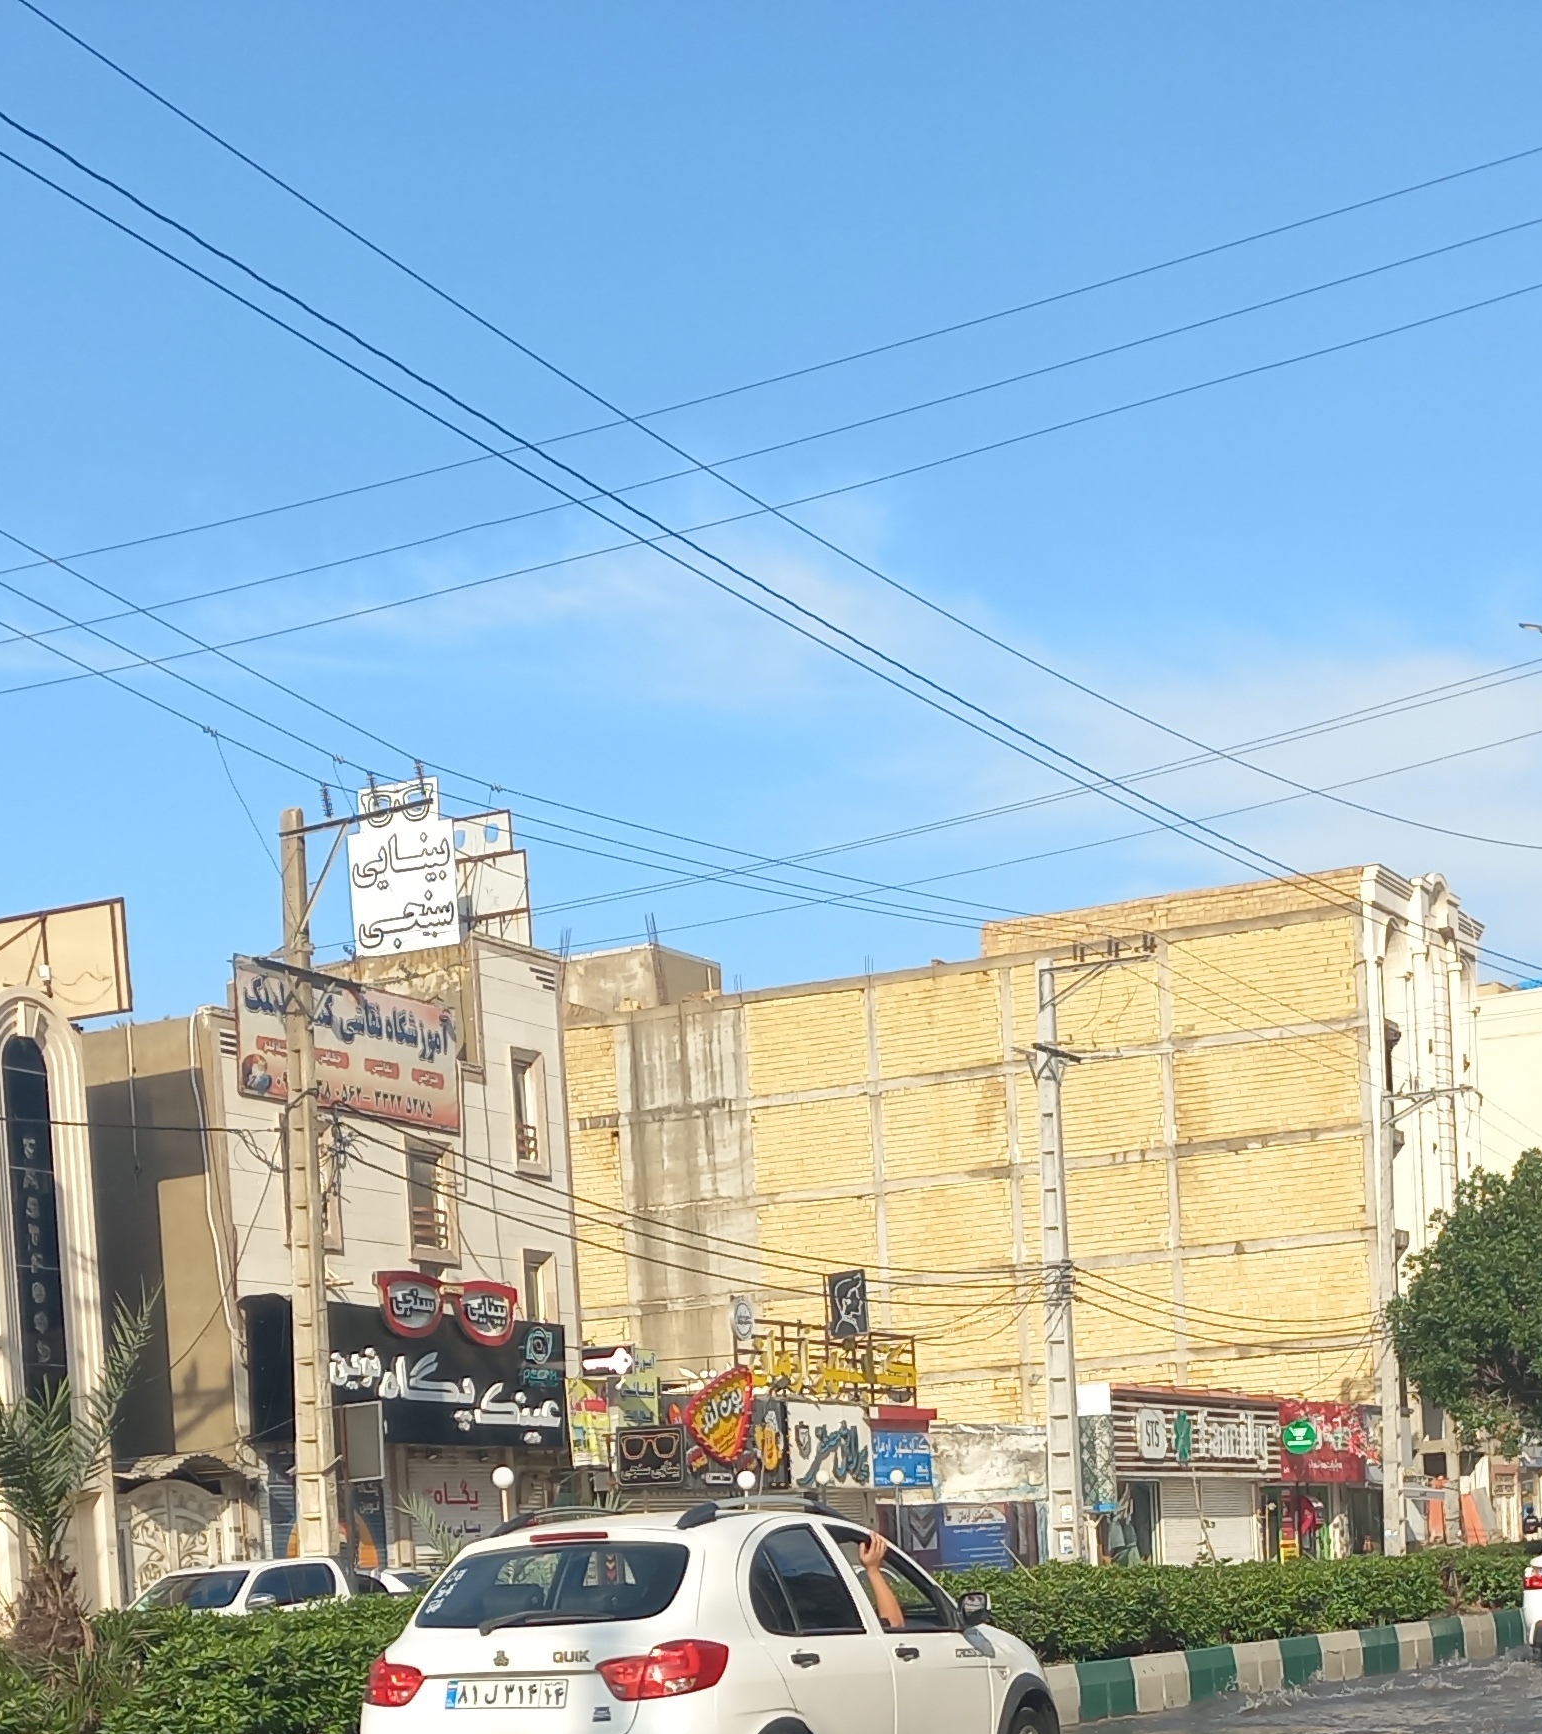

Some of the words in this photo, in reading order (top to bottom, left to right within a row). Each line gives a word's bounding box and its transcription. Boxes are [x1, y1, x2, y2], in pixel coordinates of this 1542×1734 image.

[352, 831, 450, 889] بینایی
[359, 889, 455, 949] سنجی
[473, 1382, 562, 1445] عینک
[1145, 1420, 1160, 1448] STS
[553, 1650, 591, 1664] QUIK
